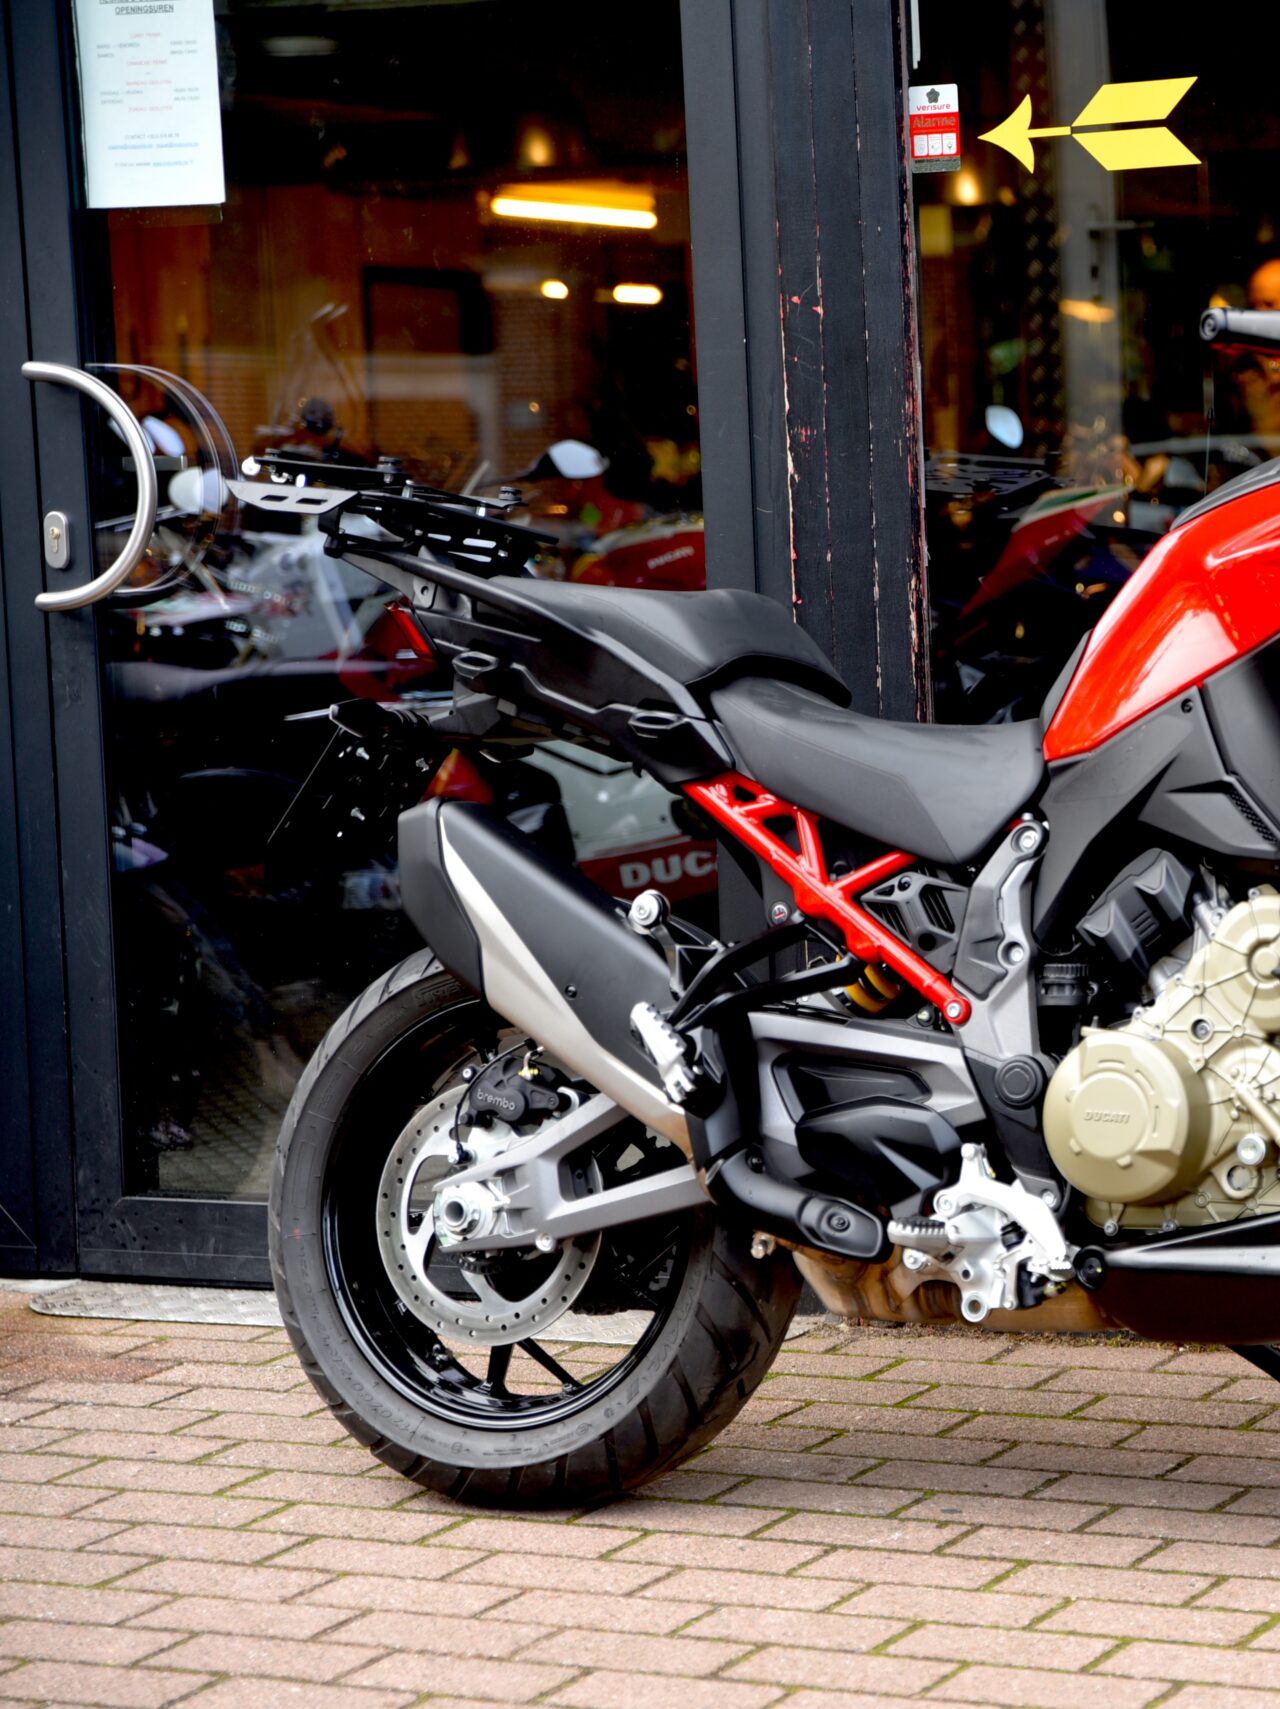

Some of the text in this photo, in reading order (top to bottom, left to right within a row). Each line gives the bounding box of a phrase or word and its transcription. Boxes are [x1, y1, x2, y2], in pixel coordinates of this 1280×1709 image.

[115, 4, 174, 15] OPENINGSUREN
[916, 103, 951, 111] verisure
[913, 115, 956, 128] Alarme
[619, 850, 718, 889] DUC
[476, 1088, 516, 1111] brembo
[1083, 1110, 1131, 1125] DUCATI
